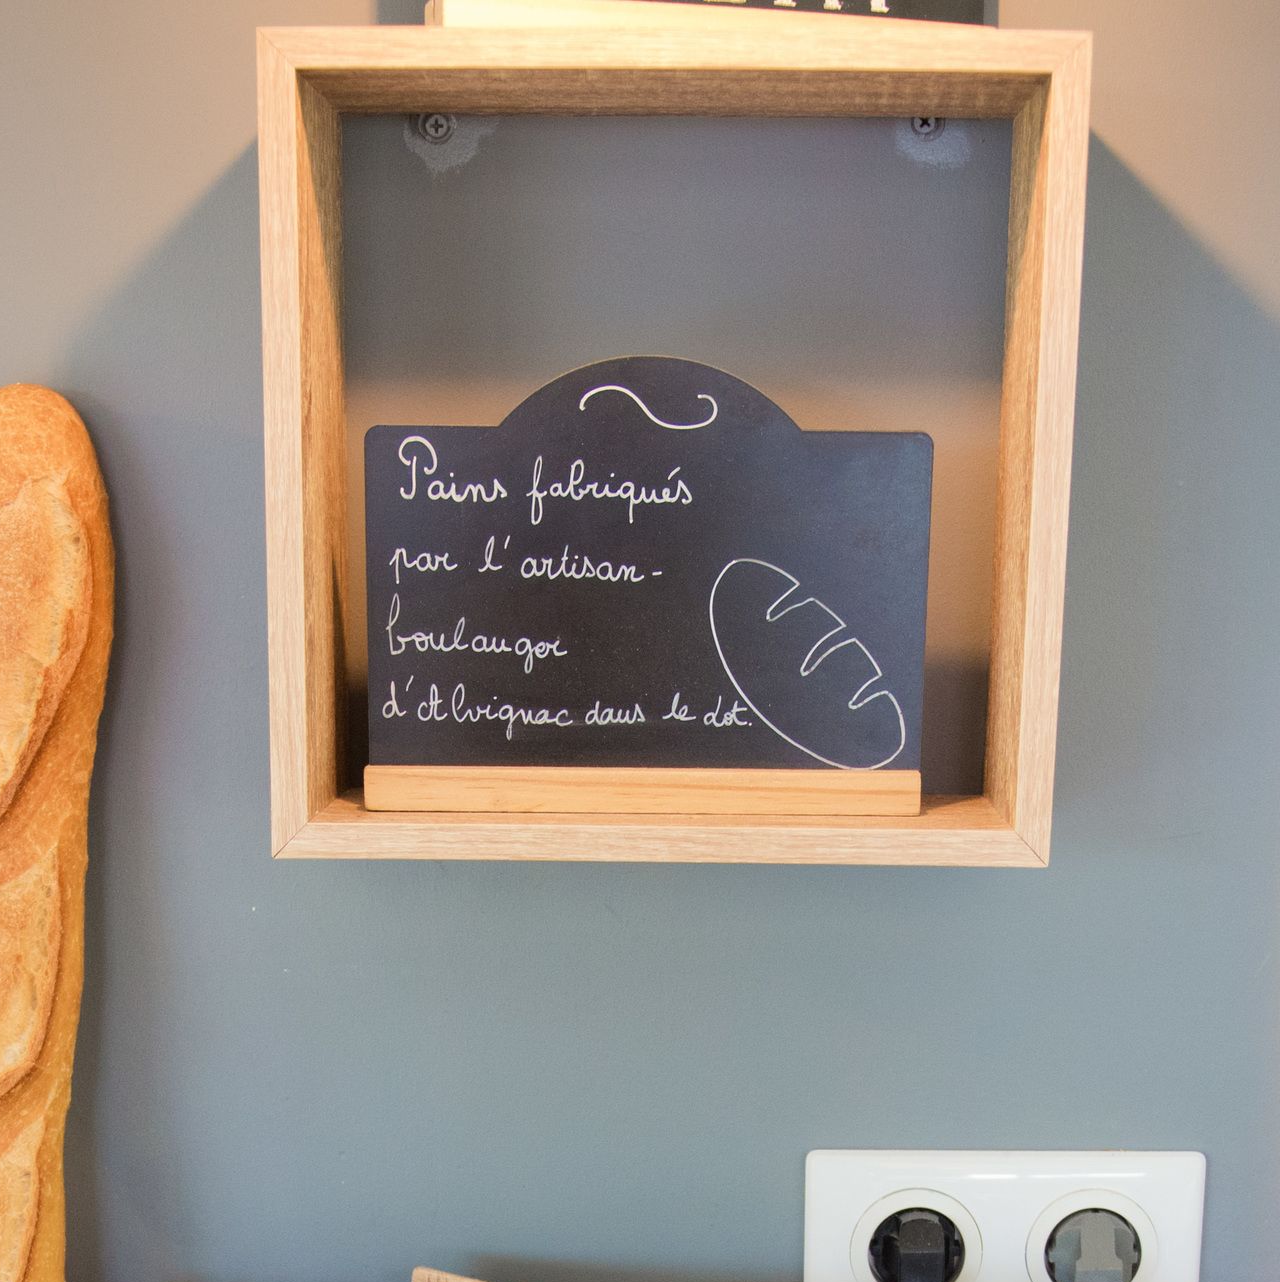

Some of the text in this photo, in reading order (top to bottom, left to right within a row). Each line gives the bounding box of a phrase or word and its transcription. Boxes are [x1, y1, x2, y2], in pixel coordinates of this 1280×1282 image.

[397, 434, 693, 526] Pains fabriqués
[388, 546, 459, 585] par
[662, 692, 697, 721] le
